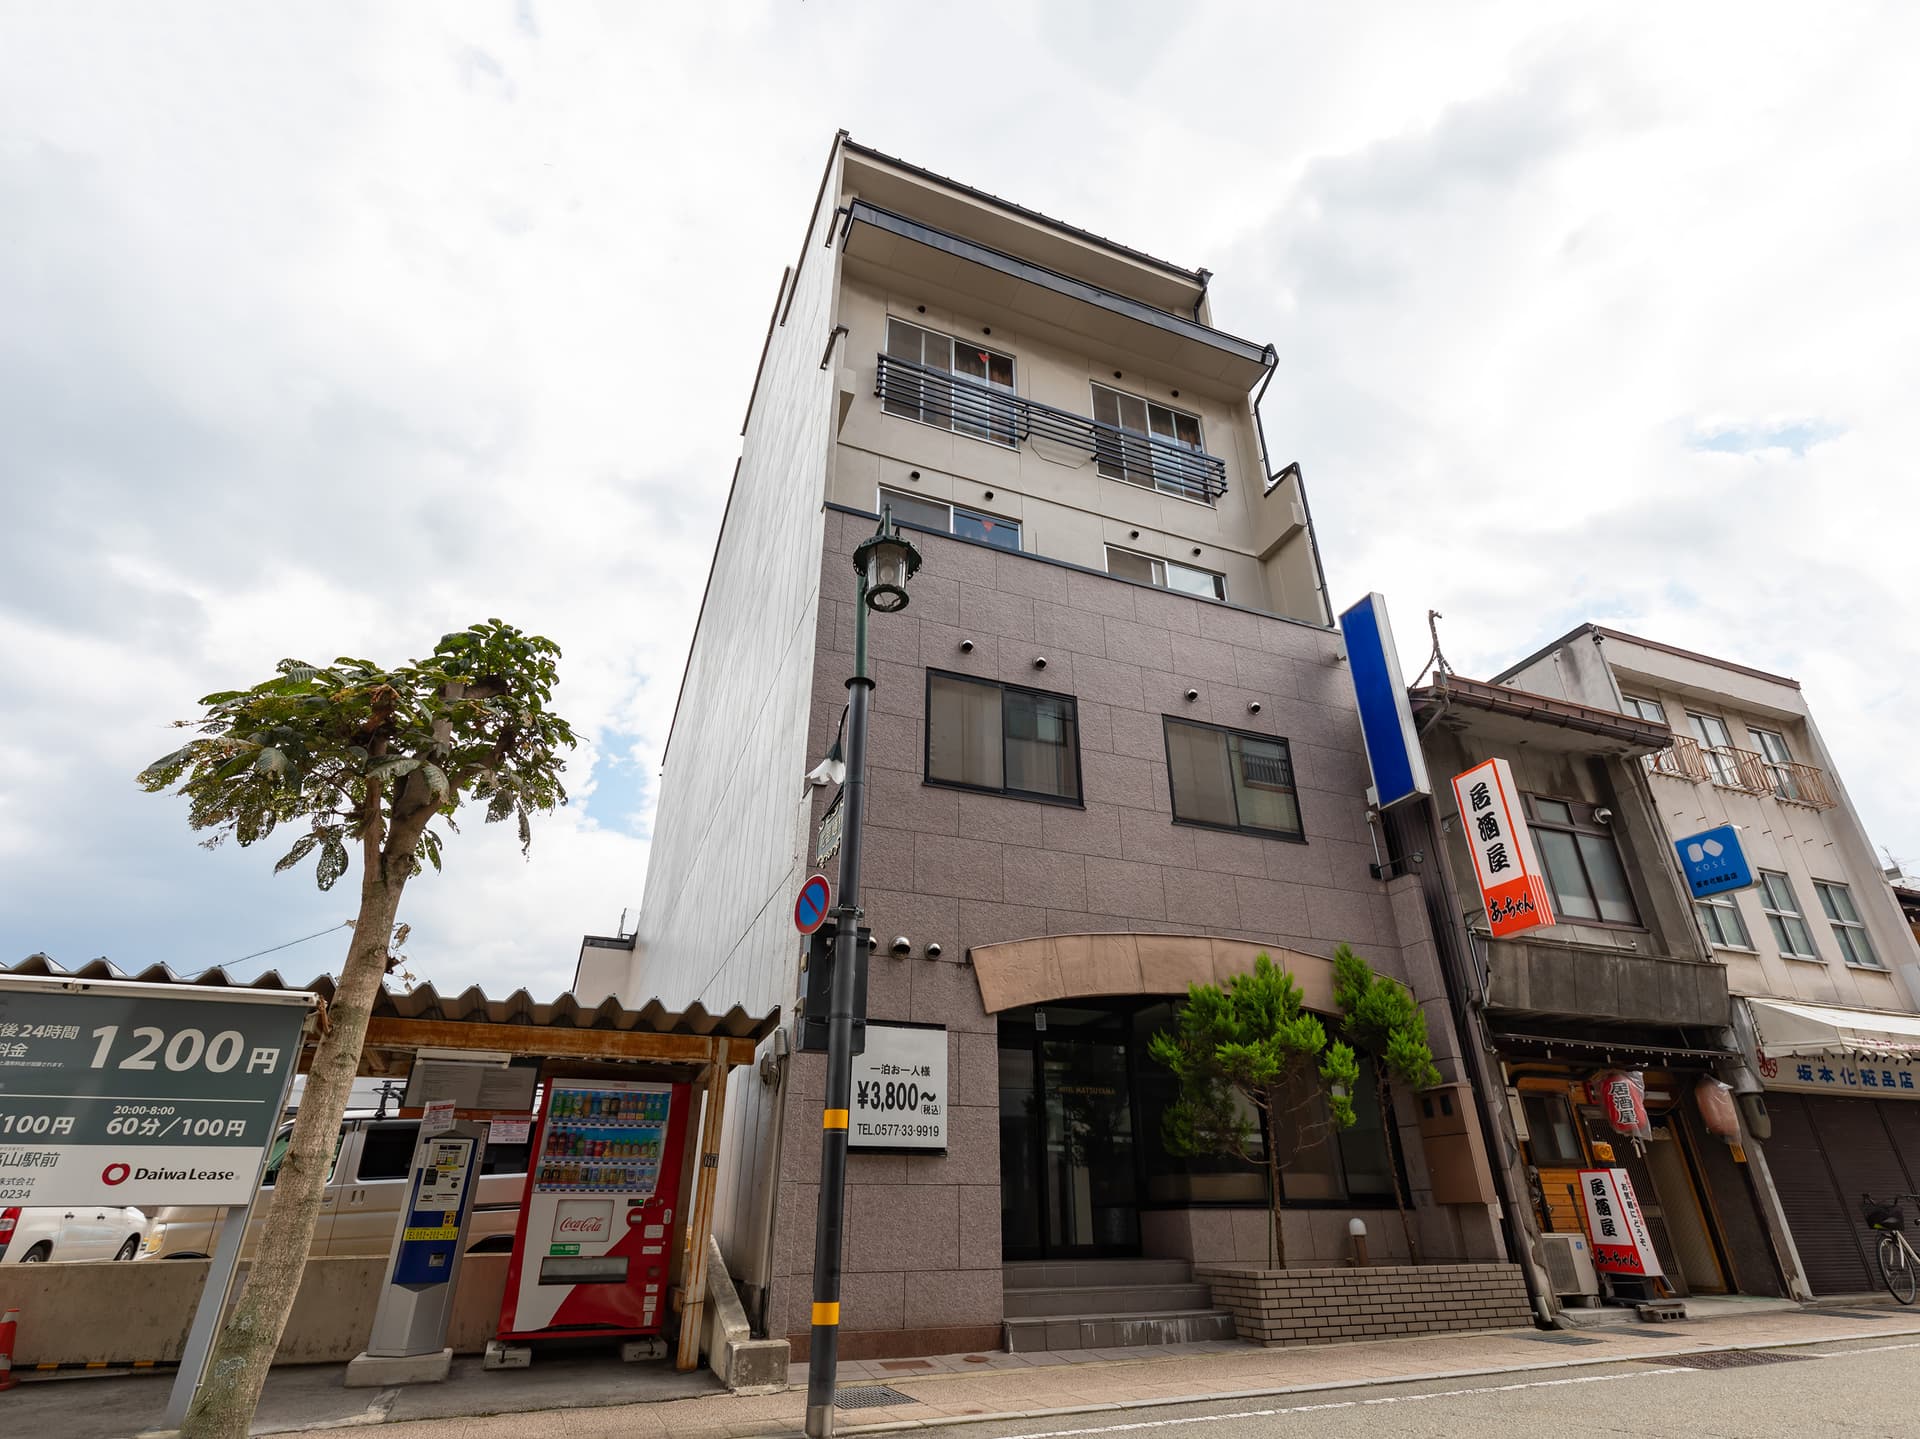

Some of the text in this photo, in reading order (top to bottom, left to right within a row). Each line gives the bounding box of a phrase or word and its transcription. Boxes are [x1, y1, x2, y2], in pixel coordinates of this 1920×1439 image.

[1469, 781, 1511, 874] 居酒屋
[1489, 892, 1535, 923] あーちゃん
[870, 1064, 931, 1077] 一泊お一人様
[1796, 1064, 1914, 1088] 坂本化粧品店
[113, 1105, 175, 1115] 20:00-8:00
[1609, 1082, 1639, 1124] 居酒屋
[1590, 1178, 1617, 1237] 居酒屋
[1597, 1248, 1639, 1267] あーちゃん
